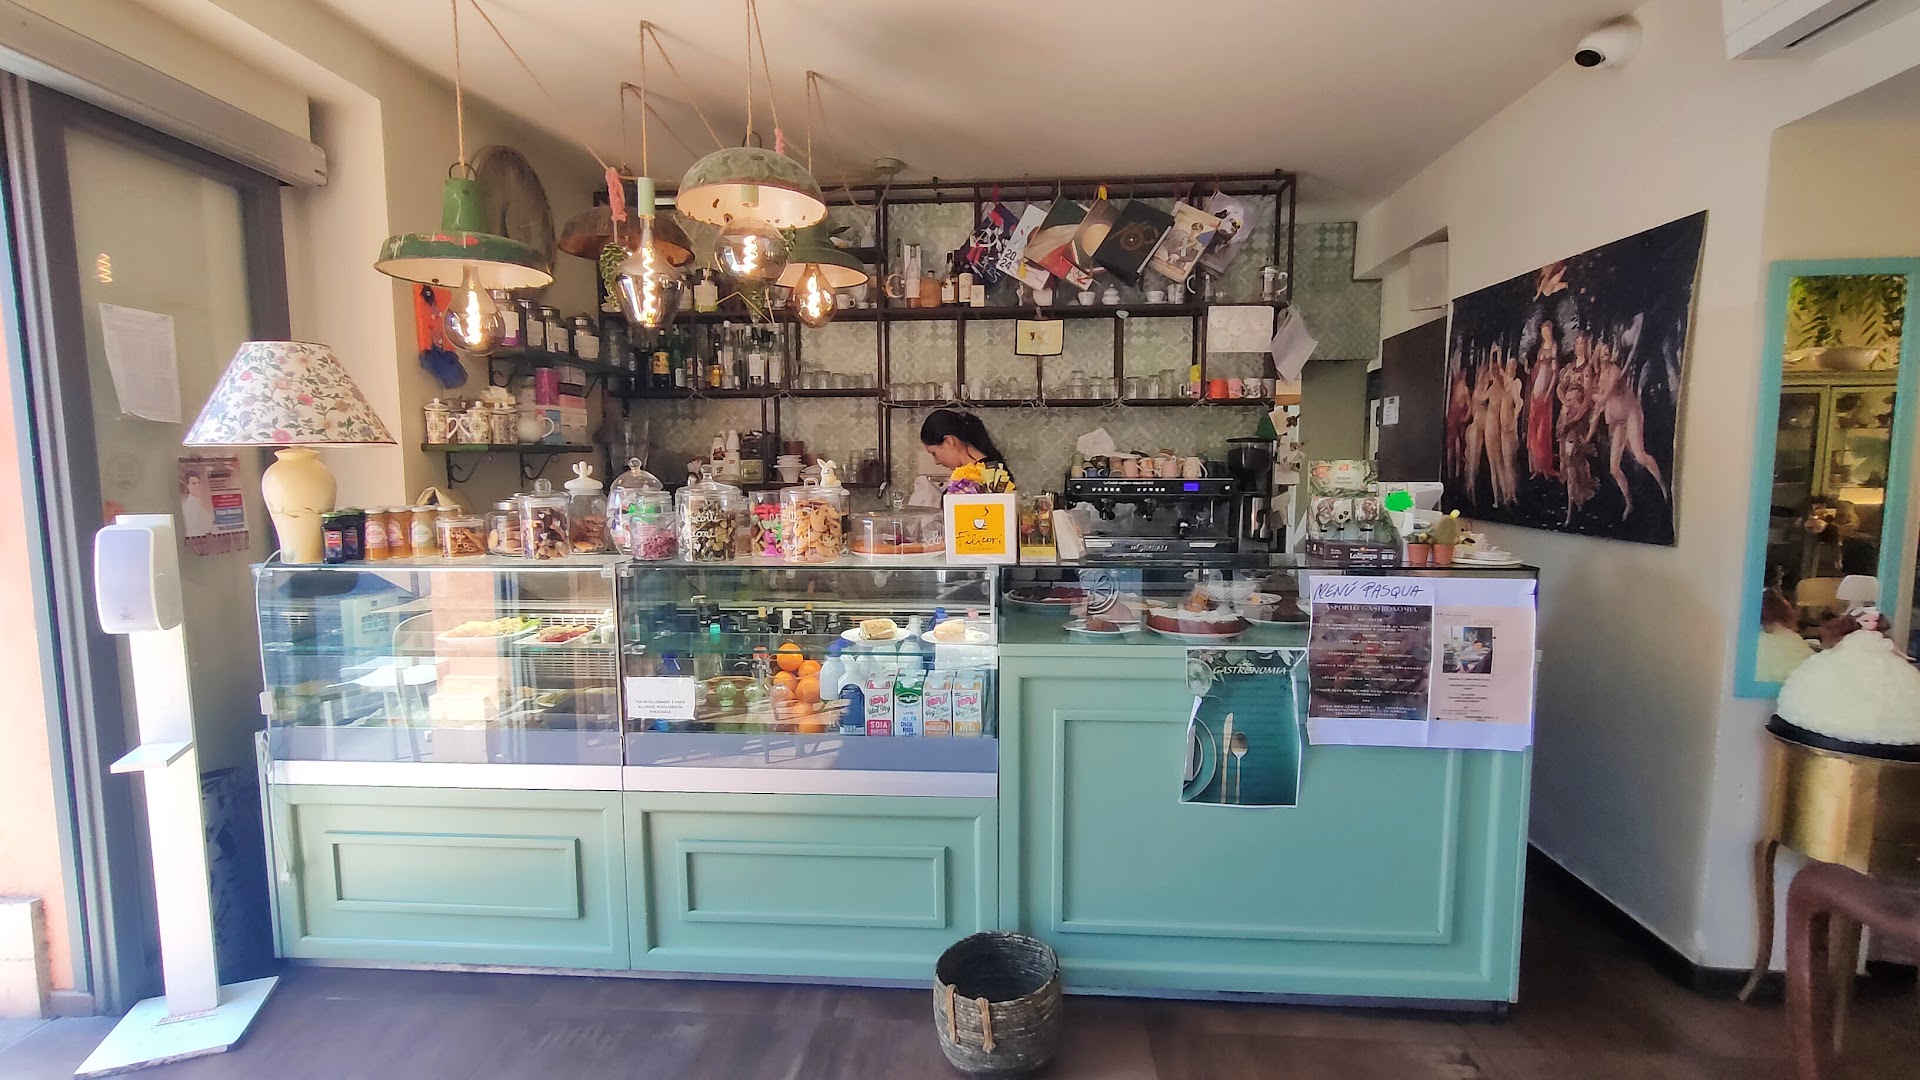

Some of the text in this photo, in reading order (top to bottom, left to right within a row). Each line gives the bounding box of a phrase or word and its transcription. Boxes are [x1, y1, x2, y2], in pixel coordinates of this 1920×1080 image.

[1004, 249, 1017, 261] 20
[999, 258, 1012, 270] 24
[955, 530, 1003, 547] Filicori
[1360, 581, 1424, 599] PASQUA
[1212, 664, 1287, 675] GASTRONOMIA
[870, 721, 888, 729] SOIA
